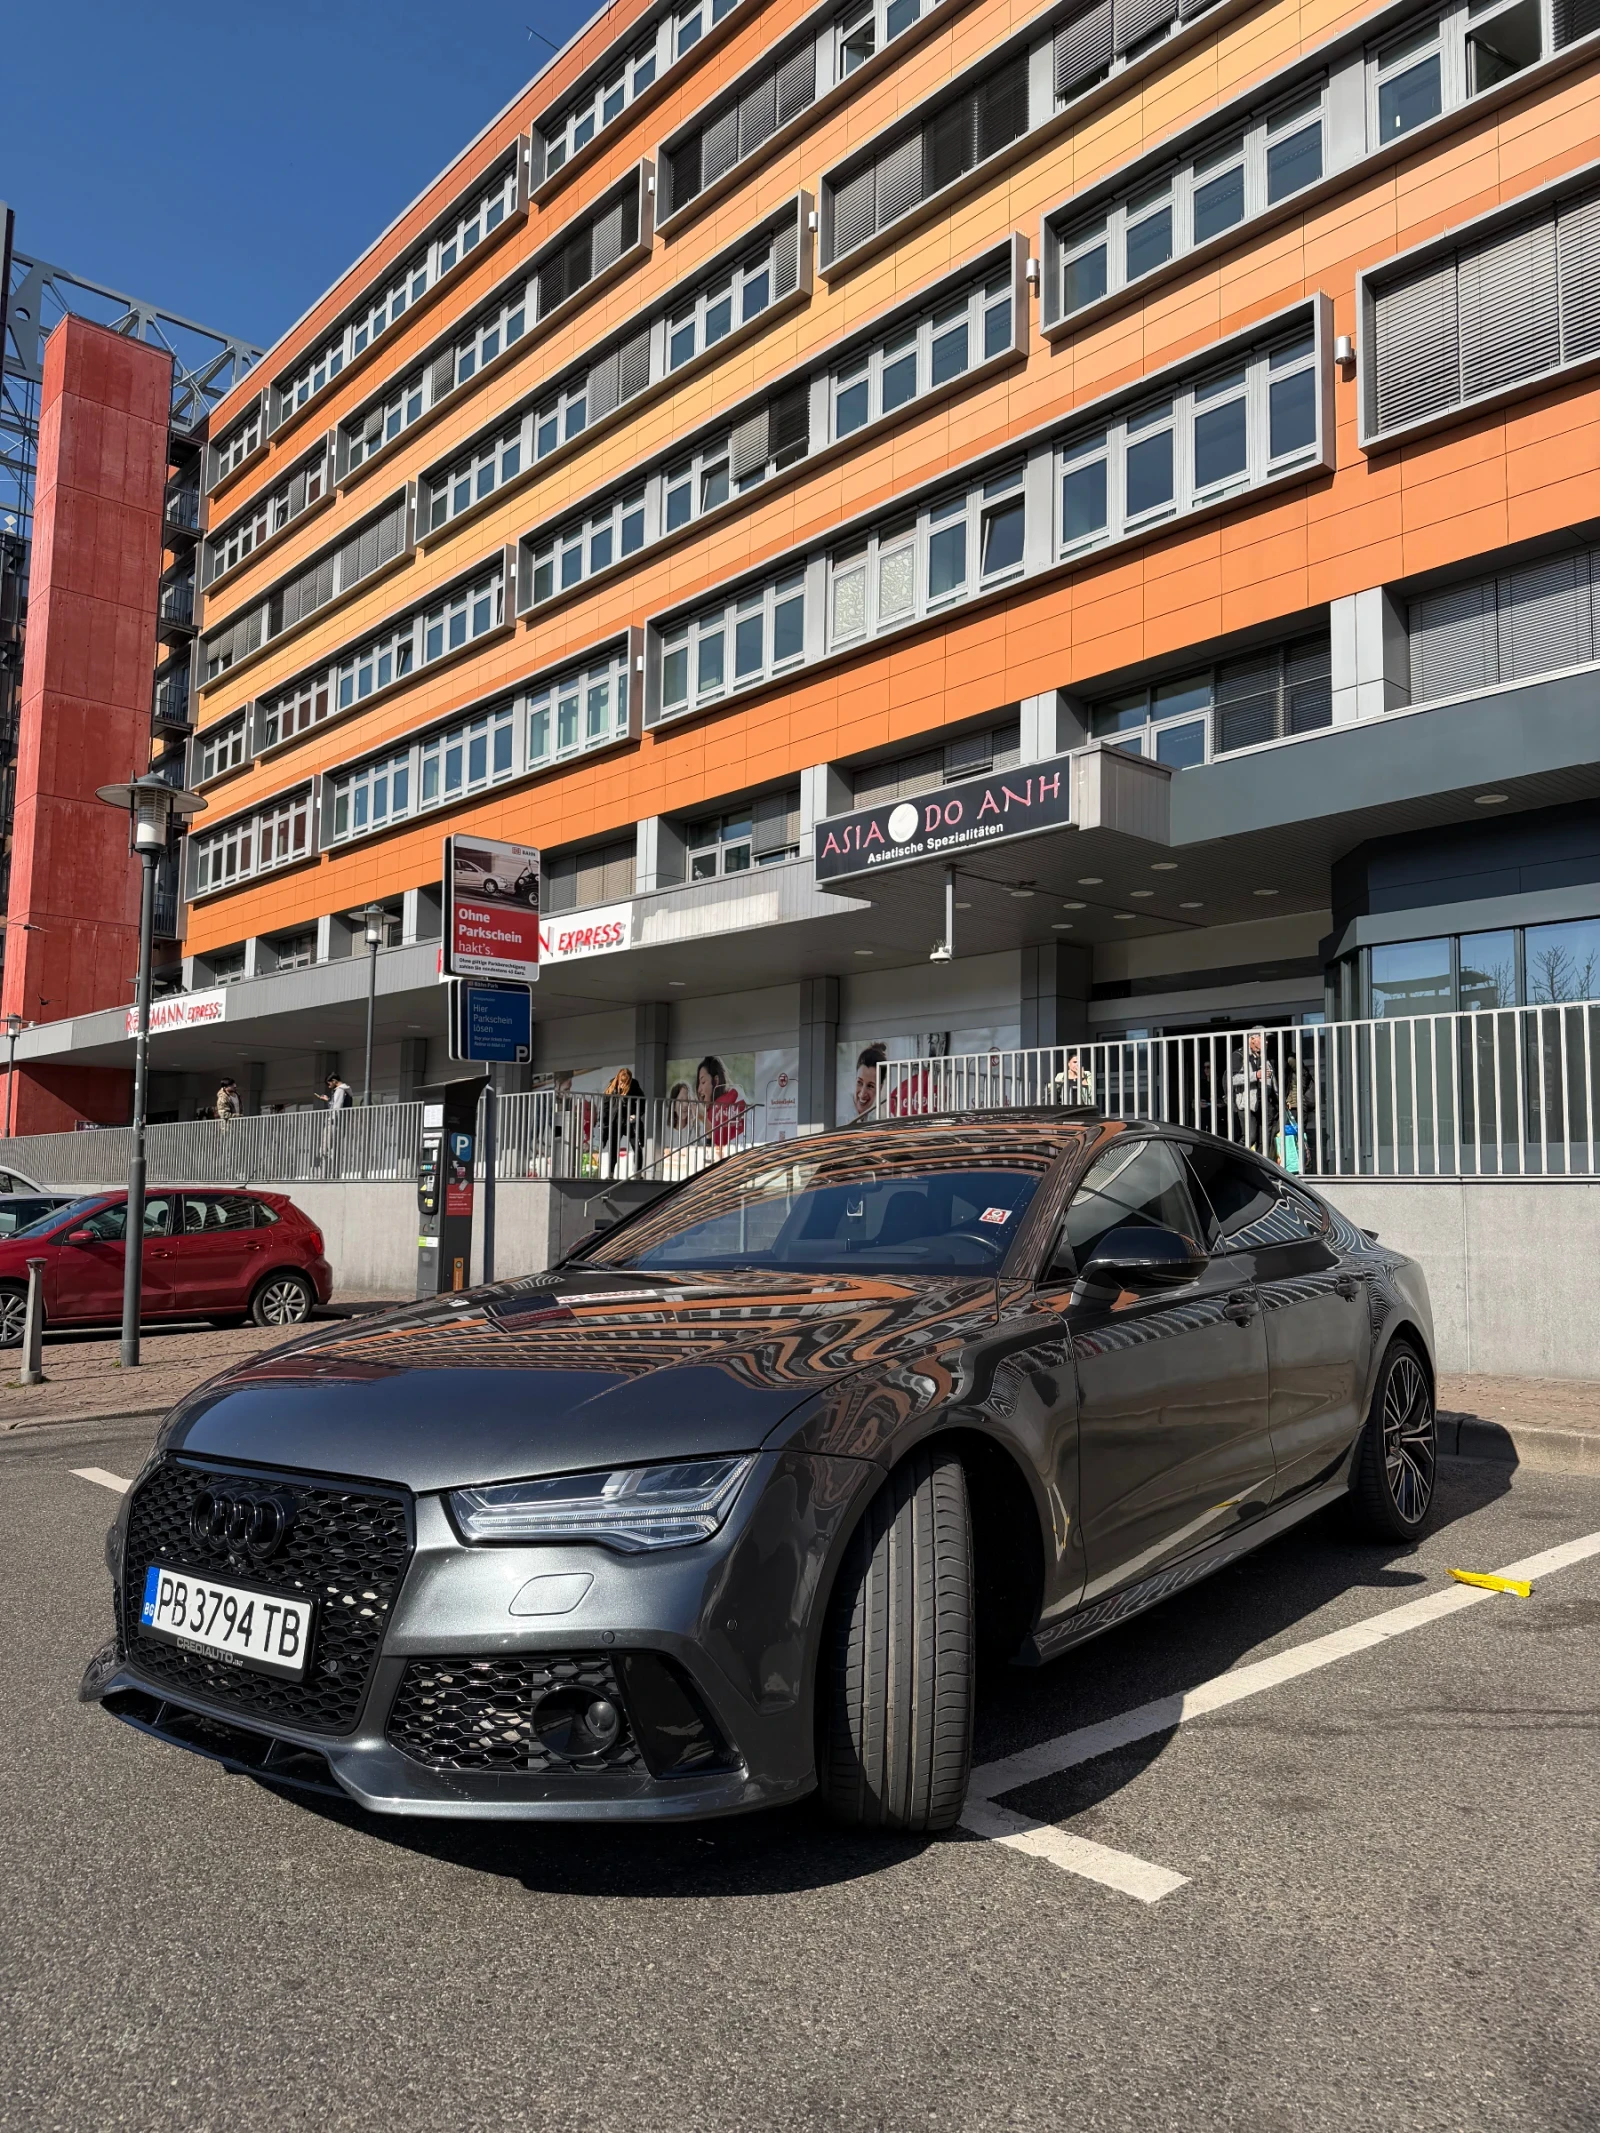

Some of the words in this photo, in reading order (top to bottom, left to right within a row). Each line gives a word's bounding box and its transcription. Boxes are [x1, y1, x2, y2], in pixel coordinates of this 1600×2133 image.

[821, 821, 885, 858] ASIA
[924, 800, 963, 832] DO
[976, 772, 1061, 820] ANH
[867, 843, 923, 864] Asiatische
[926, 823, 1004, 851] Spezialitäten
[458, 907, 491, 923] Ohne
[458, 925, 522, 944] Parkschein
[557, 921, 623, 952] EXPRESS
[188, 1001, 220, 1020] EXPRESS
[473, 1003, 489, 1013] Hier
[473, 1013, 513, 1024] Parkschein
[473, 1023, 493, 1033] lösen
[456, 1135, 469, 1156] P
[144, 1602, 155, 1617] BG
